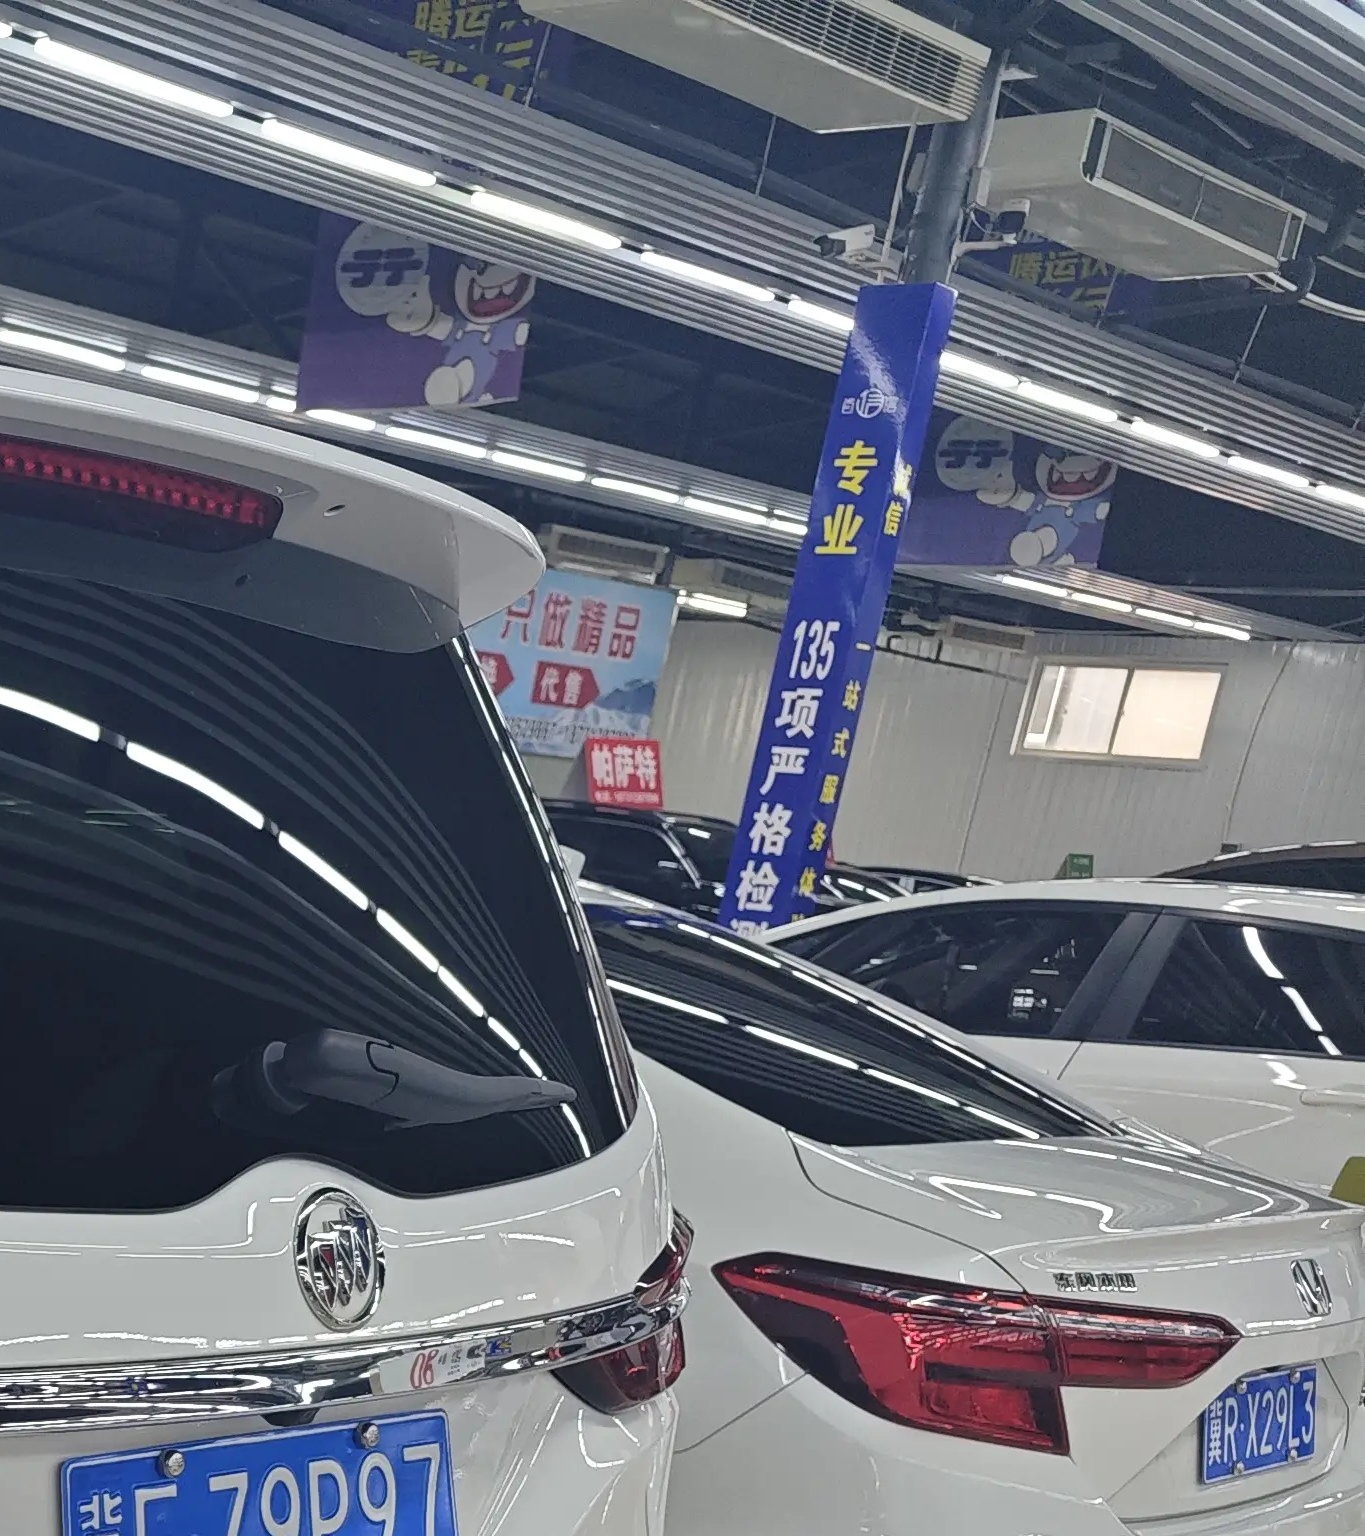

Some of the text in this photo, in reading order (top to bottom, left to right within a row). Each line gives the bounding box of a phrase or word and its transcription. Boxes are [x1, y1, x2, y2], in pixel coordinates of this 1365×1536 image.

[814, 439, 879, 556] 专业
[500, 588, 641, 660] 只做精品
[539, 666, 585, 706] 代售
[590, 742, 658, 791] 帕萨特
[1209, 1382, 1314, 1466] 冀R·X29L3
